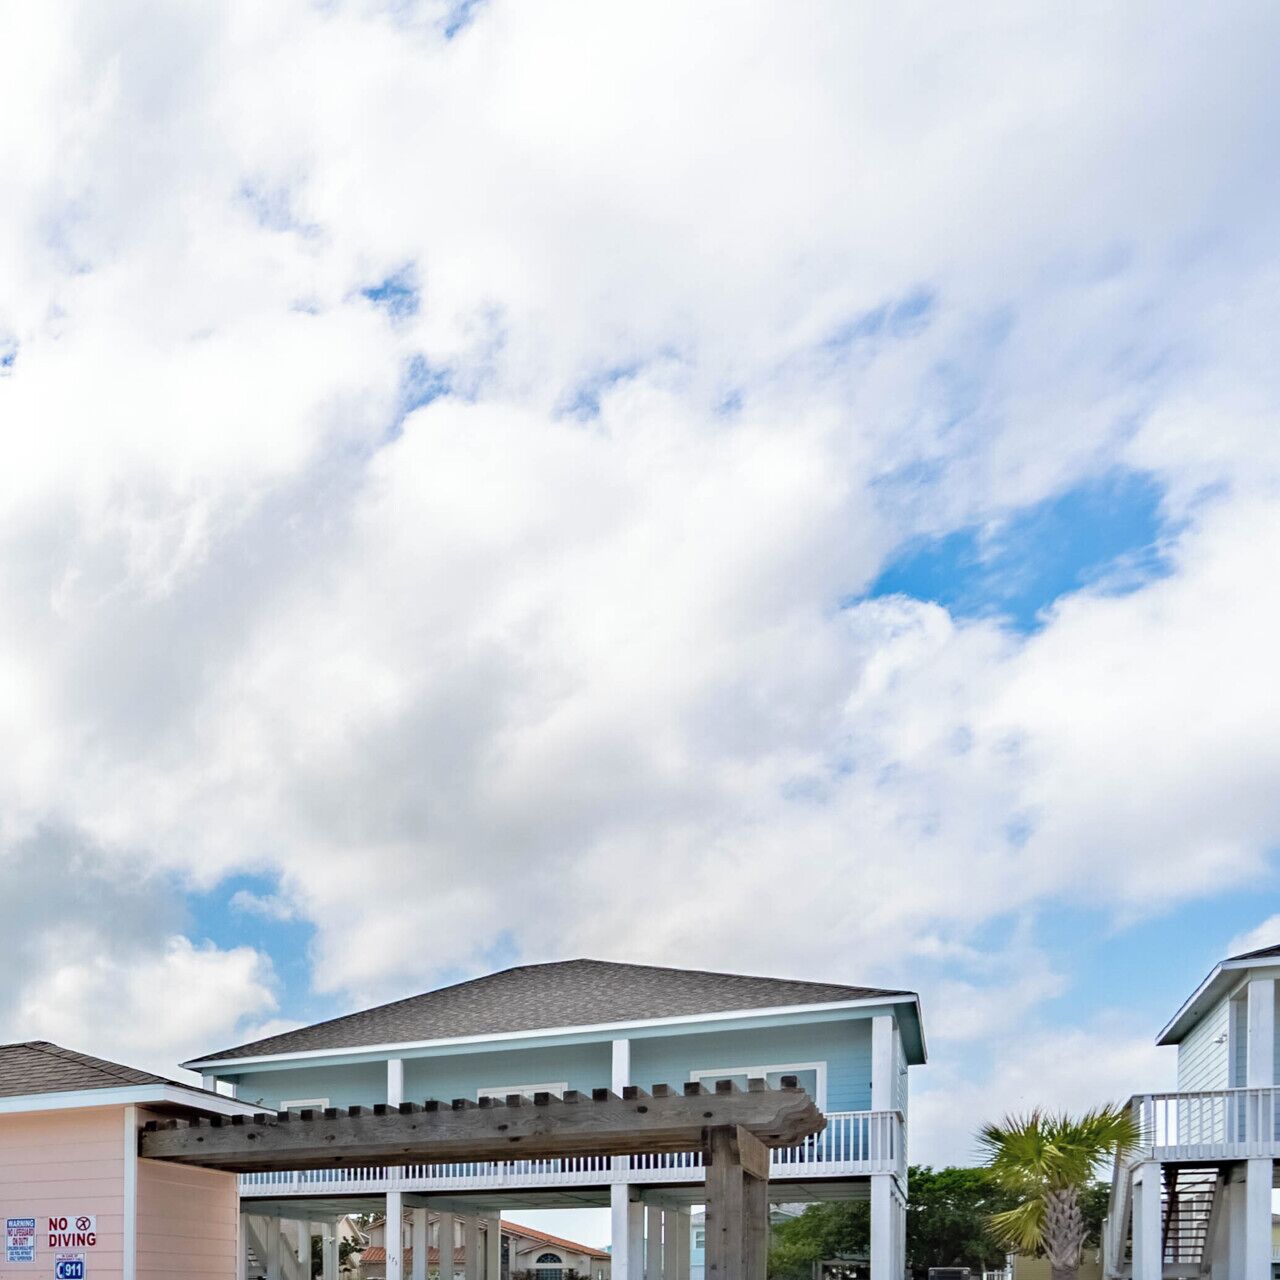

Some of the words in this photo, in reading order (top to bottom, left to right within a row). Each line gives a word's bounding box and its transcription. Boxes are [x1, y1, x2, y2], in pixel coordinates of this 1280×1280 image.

[49, 1217, 68, 1231] NO
[48, 1232, 96, 1247] DIVING
[65, 1263, 81, 1276] 911
